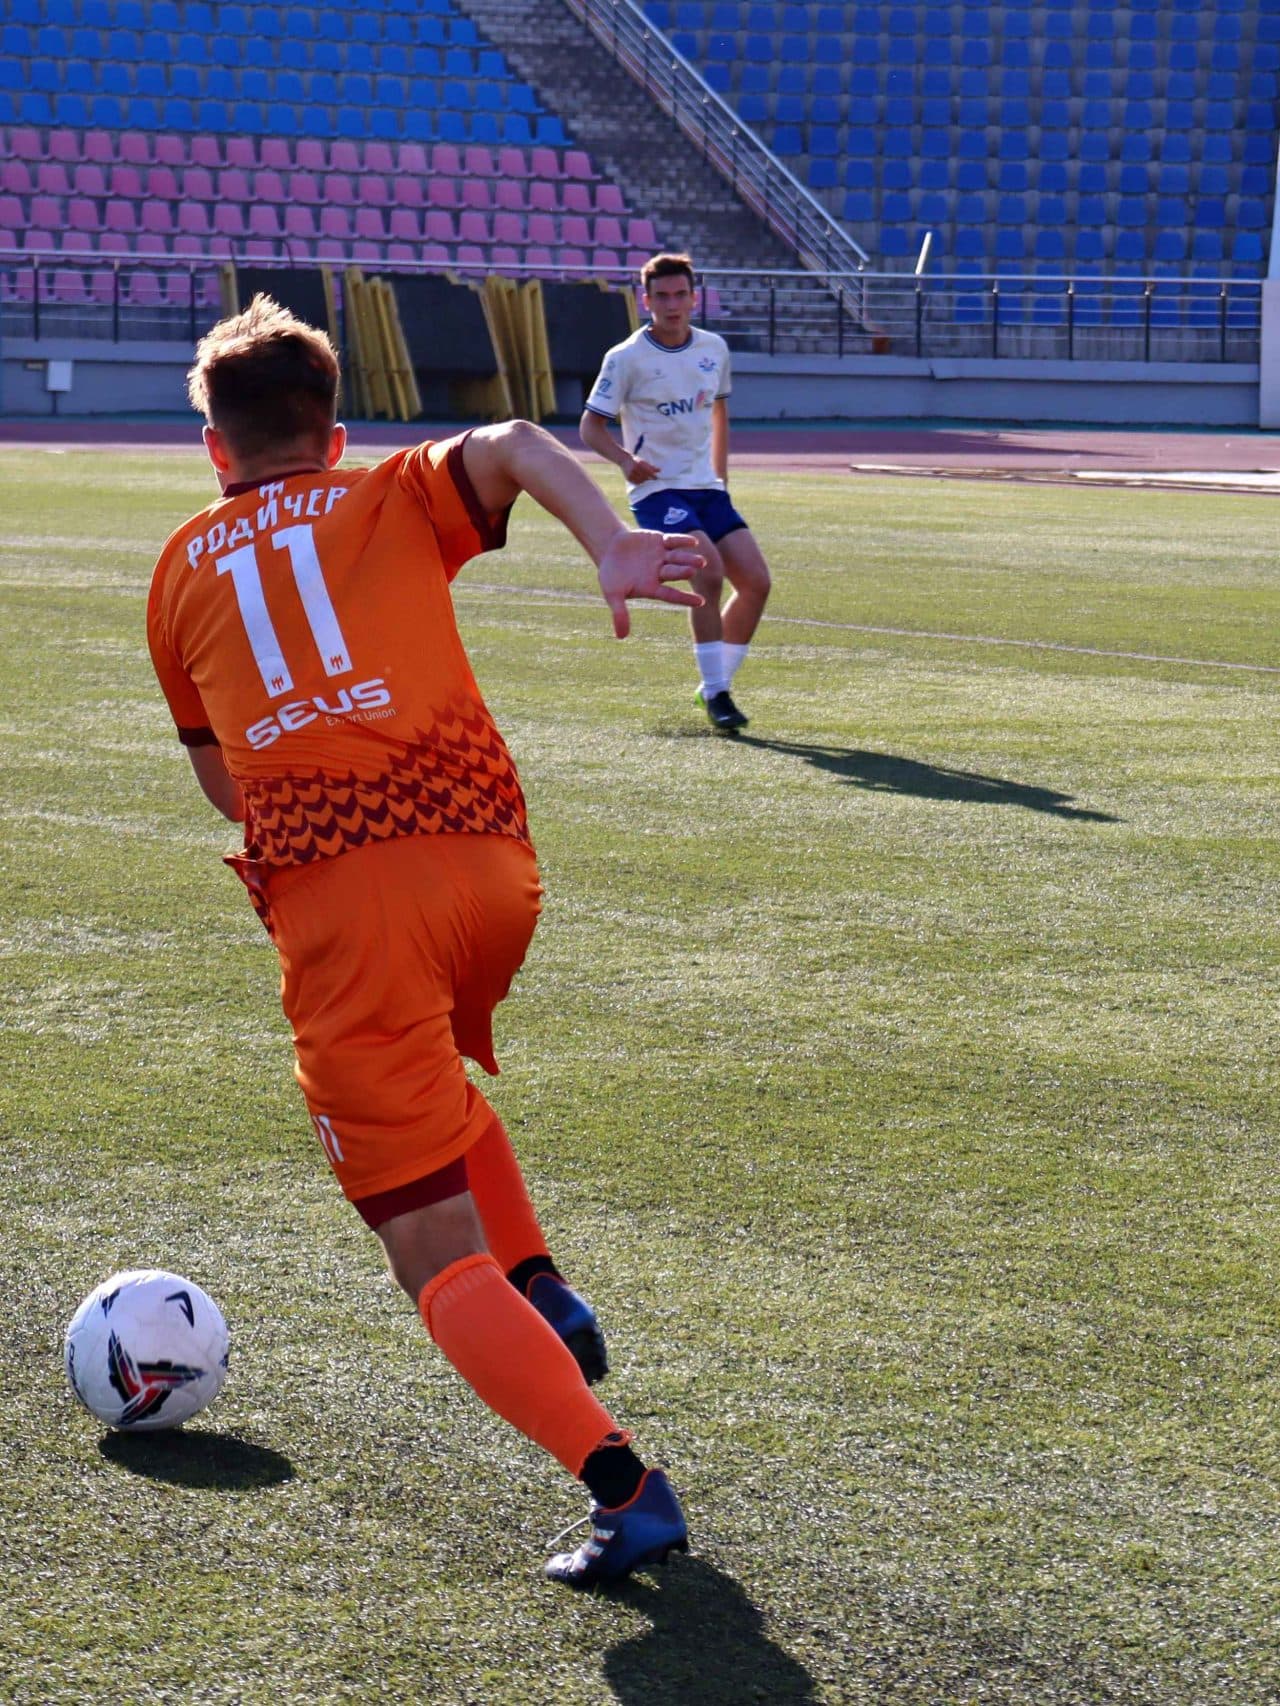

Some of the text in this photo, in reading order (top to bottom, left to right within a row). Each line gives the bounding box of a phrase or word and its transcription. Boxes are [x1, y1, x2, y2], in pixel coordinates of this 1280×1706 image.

[656, 398, 693, 416] GNV
[215, 523, 353, 699] 11
[245, 678, 391, 750] SEUS
[363, 708, 396, 721] Union
